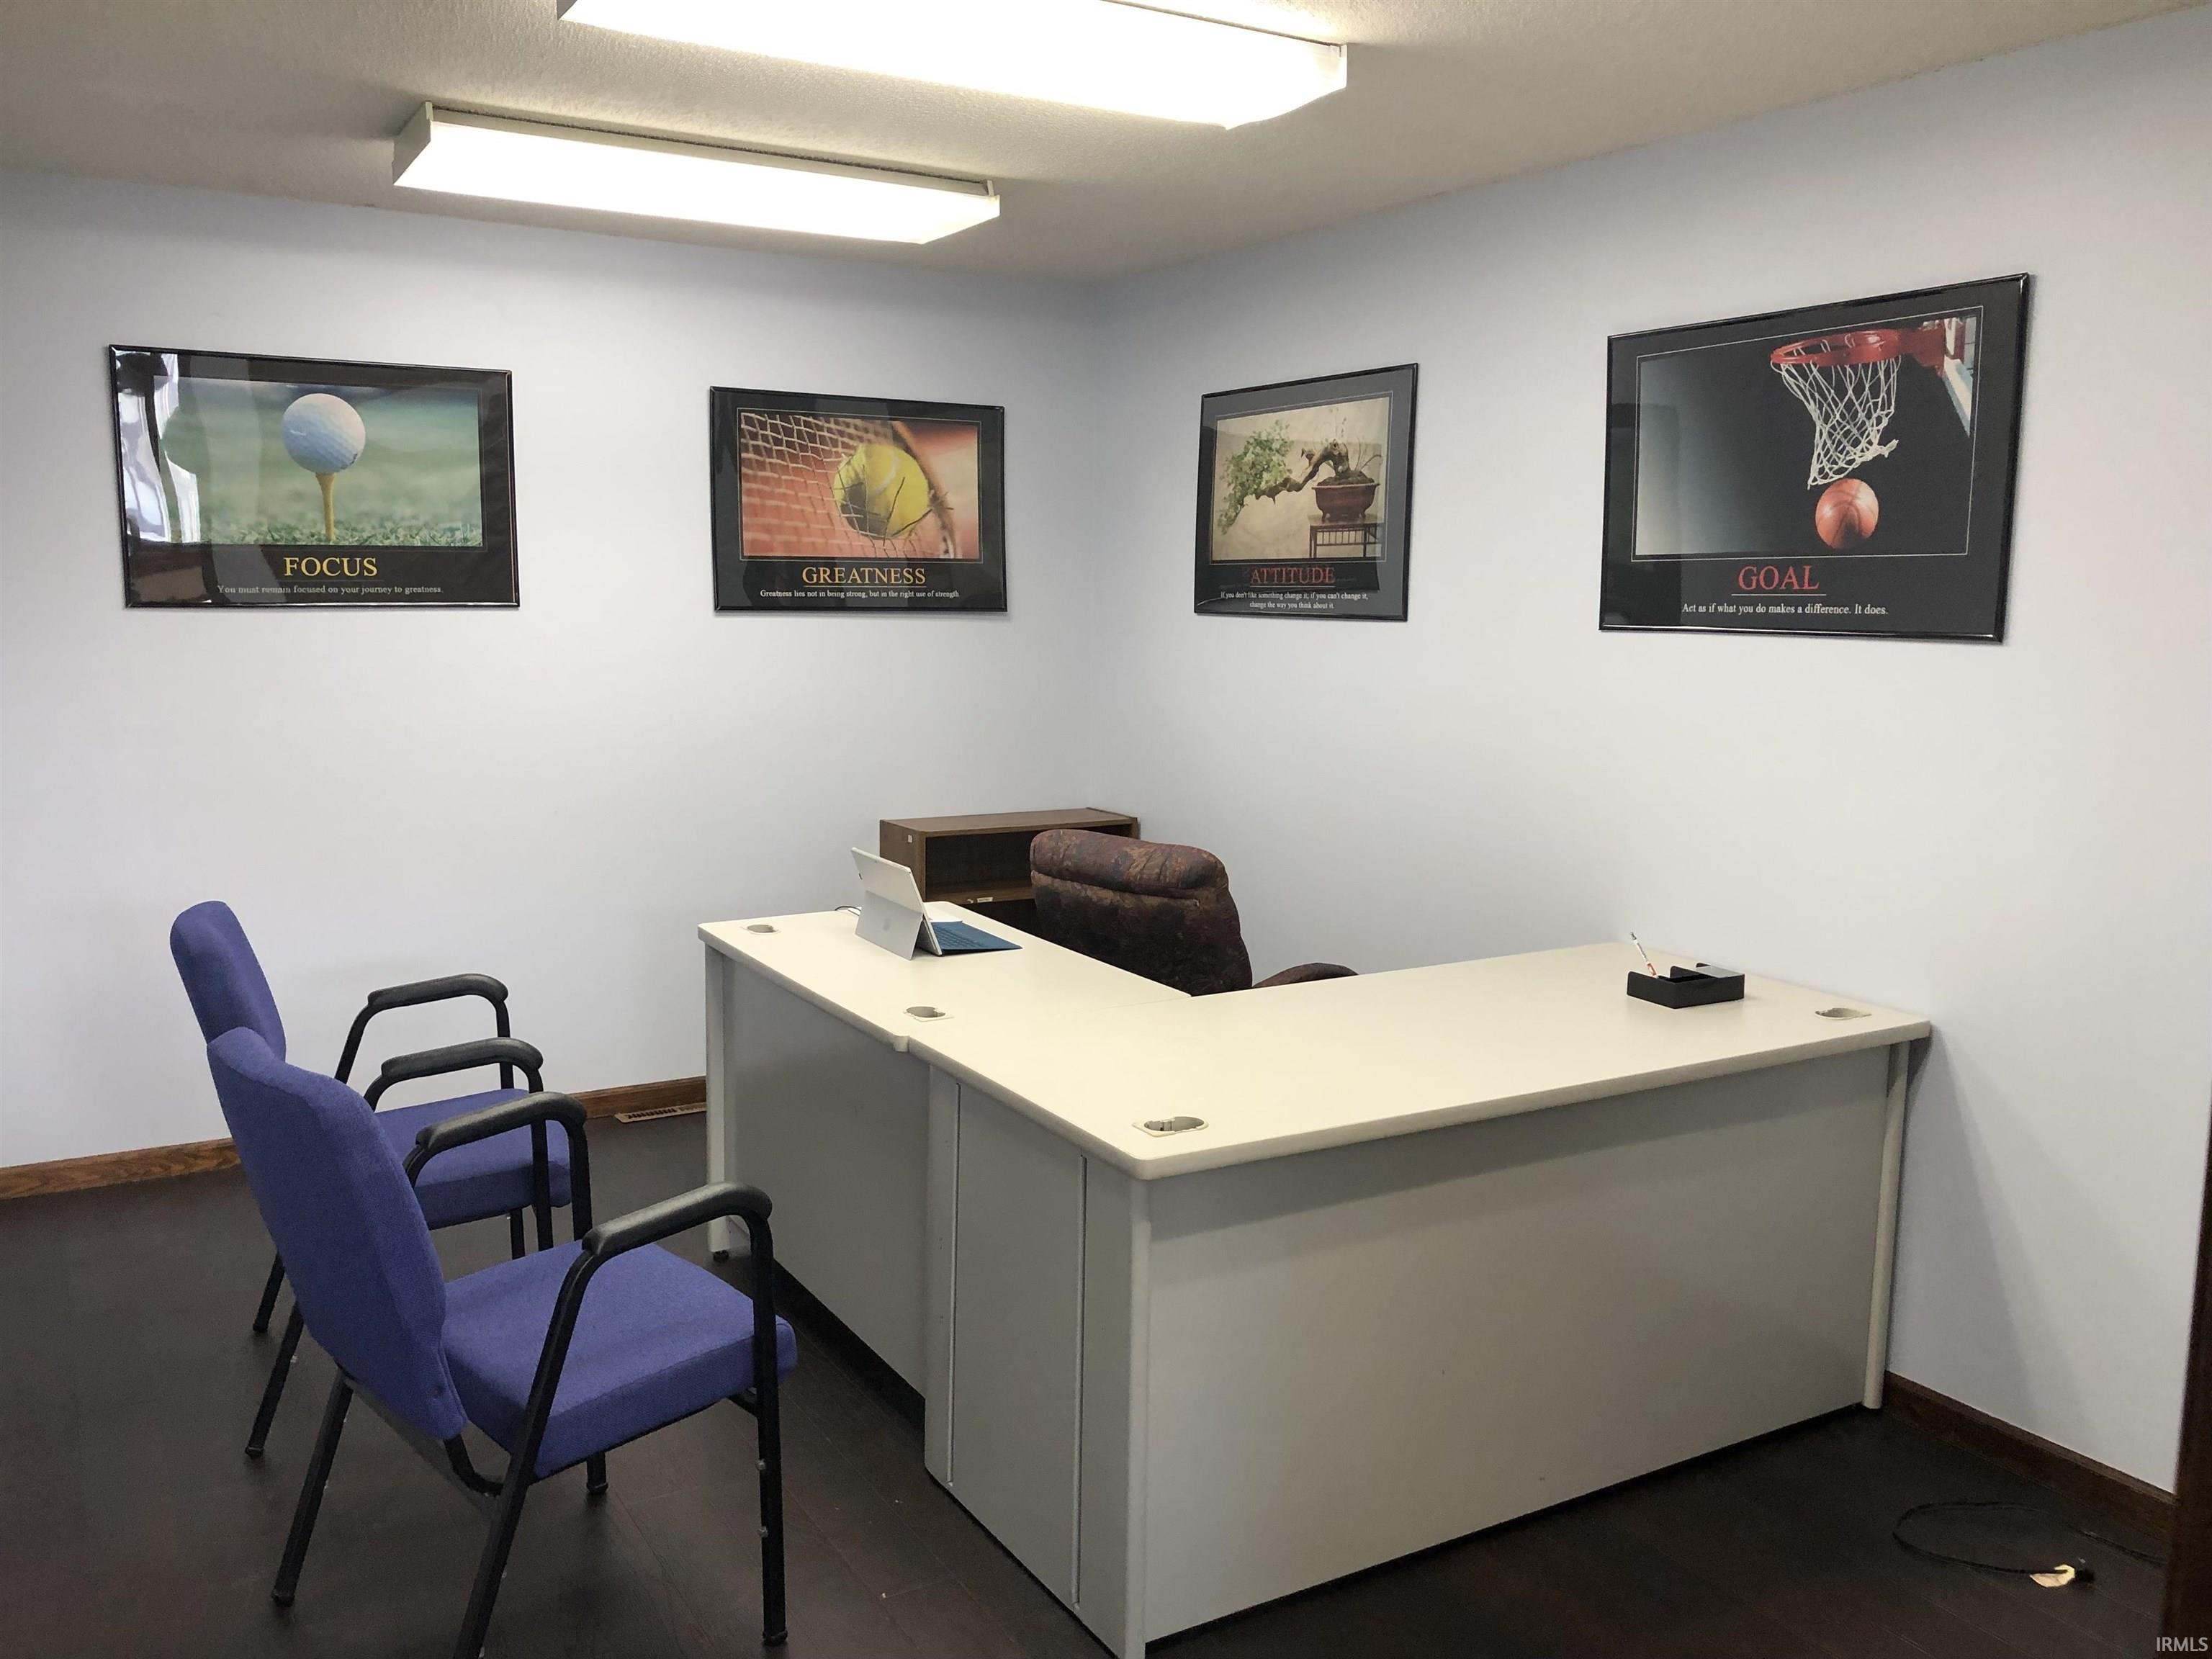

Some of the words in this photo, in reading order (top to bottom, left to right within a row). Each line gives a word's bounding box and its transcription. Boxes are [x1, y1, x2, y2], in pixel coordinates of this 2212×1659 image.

[283, 557, 378, 577] FOCUS
[801, 567, 927, 585] GREATNESS
[1250, 567, 1336, 585] ATTITUDE
[1738, 565, 1820, 590] GOAL
[217, 585, 236, 594] You
[238, 585, 260, 594] must
[293, 585, 326, 594] focused
[341, 586, 360, 595] your
[361, 585, 392, 595] journey
[760, 589, 792, 598] Greatness
[827, 590, 845, 598] being
[869, 590, 879, 598] but
[899, 590, 914, 599] right
[1258, 591, 1284, 601] something
[1284, 591, 1303, 601] change
[1341, 592, 1361, 601] change
[1682, 603, 1696, 613] Act
[1709, 603, 1717, 613] if
[1717, 603, 1737, 613] what
[1738, 606, 1754, 616] you
[1755, 603, 1766, 613] do
[1768, 603, 1795, 613] makes
[1804, 603, 1852, 614] difference.
[1854, 603, 1862, 614] It
[1863, 603, 1889, 615] does.
